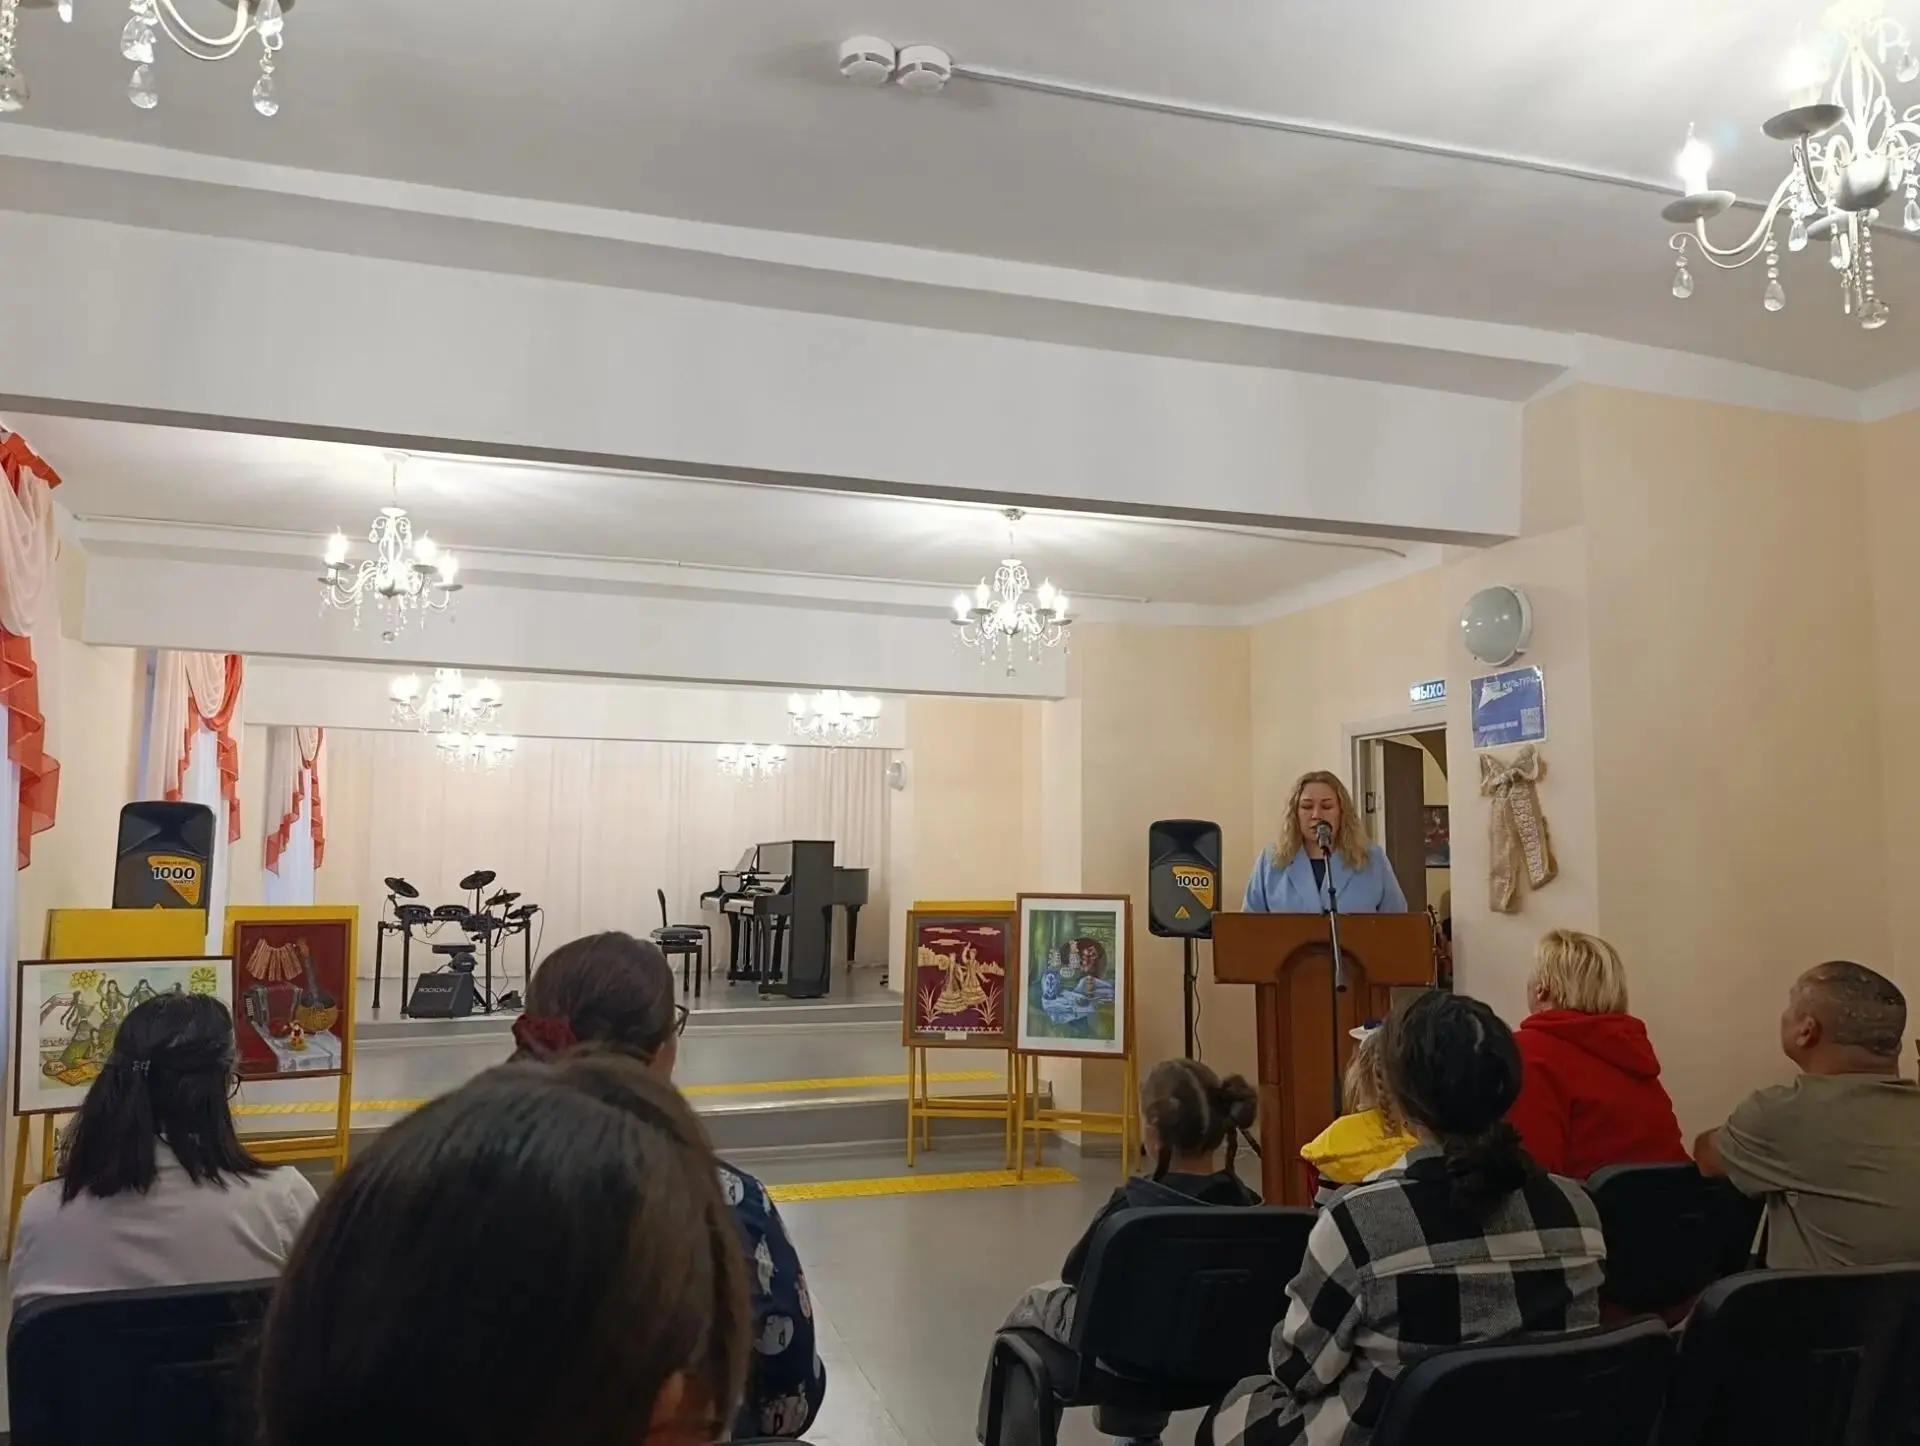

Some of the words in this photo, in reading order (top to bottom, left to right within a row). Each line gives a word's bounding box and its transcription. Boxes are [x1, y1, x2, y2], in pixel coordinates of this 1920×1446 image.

[1411, 683, 1445, 700] ВЫХО
[152, 866, 195, 880] 1000
[1176, 875, 1209, 887] 1000
